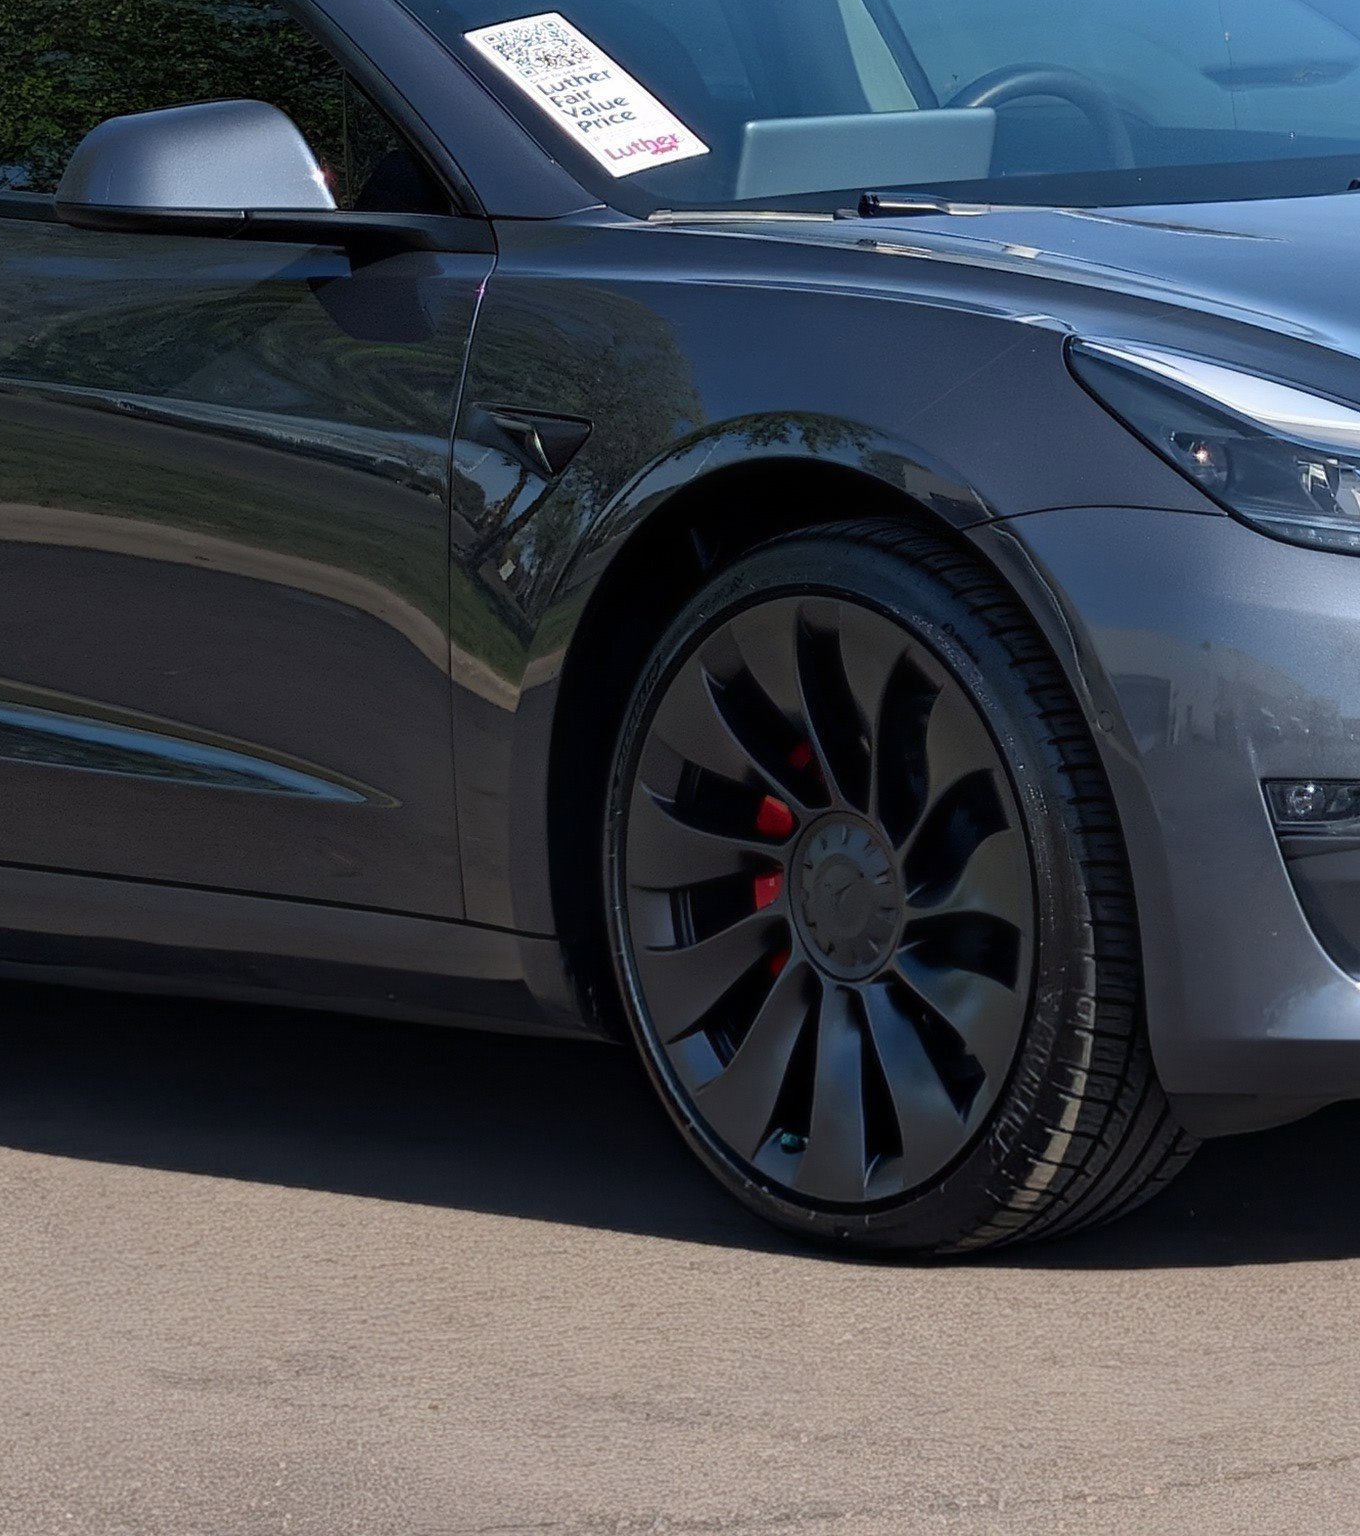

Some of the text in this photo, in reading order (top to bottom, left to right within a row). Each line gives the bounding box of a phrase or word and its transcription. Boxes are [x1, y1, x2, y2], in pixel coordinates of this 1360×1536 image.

[536, 69, 612, 96] Luther
[549, 89, 592, 108] Fair
[561, 95, 629, 119] Value
[577, 109, 637, 134] Price
[603, 133, 680, 162] Luther
